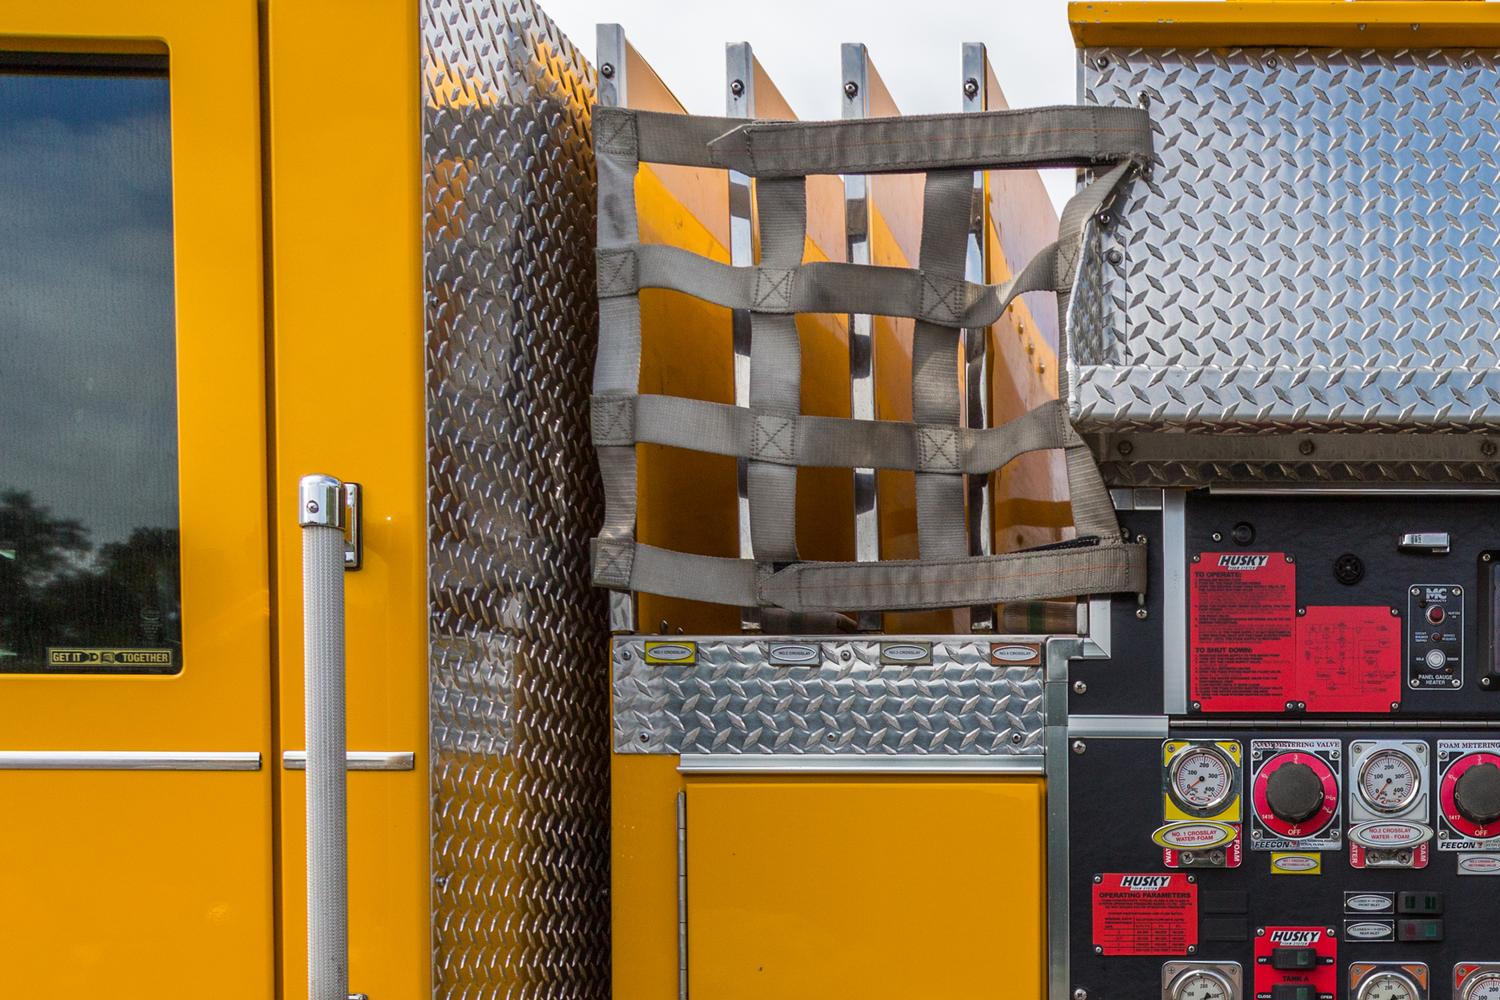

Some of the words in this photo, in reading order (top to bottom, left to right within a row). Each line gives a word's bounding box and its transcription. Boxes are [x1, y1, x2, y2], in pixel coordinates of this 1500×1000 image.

[1220, 555, 1268, 566] HUSKY
[1426, 588, 1447, 598] MC
[53, 653, 69, 662] GET
[73, 653, 81, 662] IT
[123, 653, 168, 662] TOGETHER
[1122, 876, 1169, 886] HUSKY
[1272, 932, 1319, 941] HUSKY
